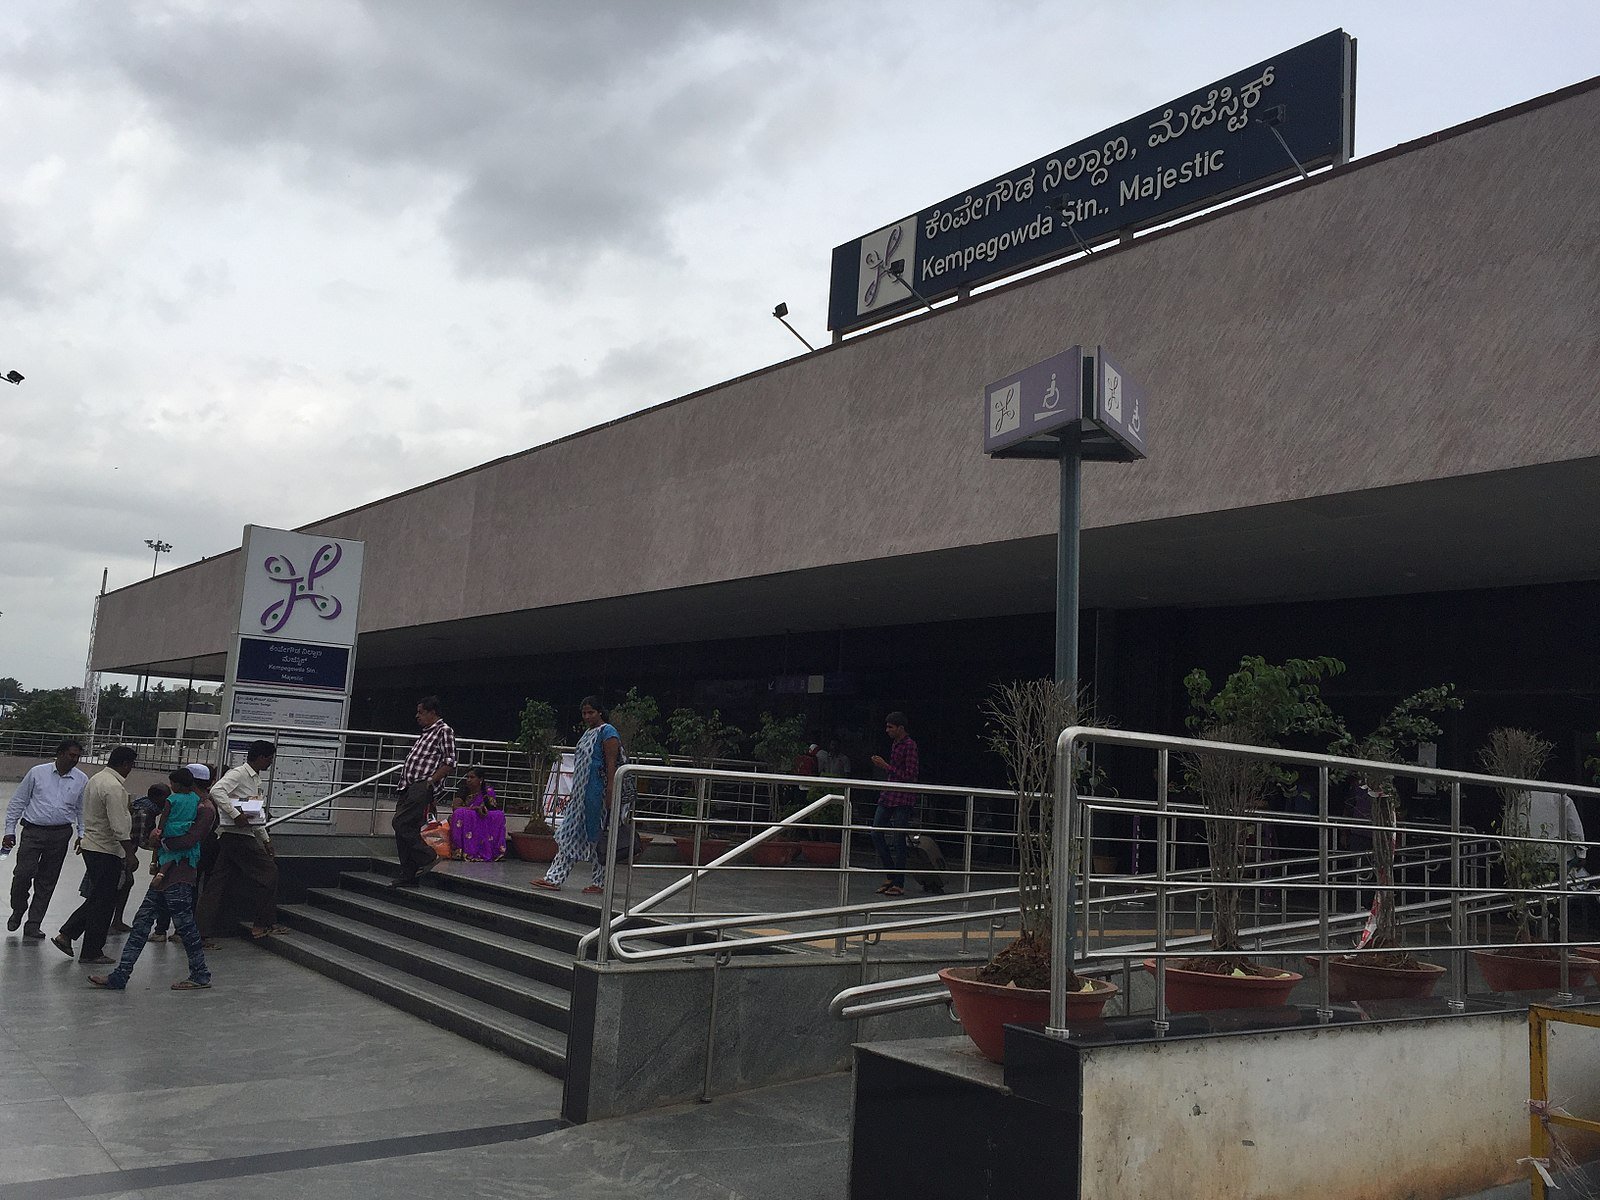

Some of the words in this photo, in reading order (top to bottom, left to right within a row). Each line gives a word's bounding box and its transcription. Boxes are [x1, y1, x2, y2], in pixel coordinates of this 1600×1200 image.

[922, 213, 1053, 281] Kempegowda
[1061, 198, 1109, 228] Stn.,
[1119, 149, 1225, 207] Majestic
[925, 167, 1036, 239] ಕೆಂಪೇಗೌಡ
[1042, 136, 1137, 193] ನಿಲ್ದಾಣ,
[1148, 66, 1275, 147] ಮೆಜೆಸ್ಟಿಕ್
